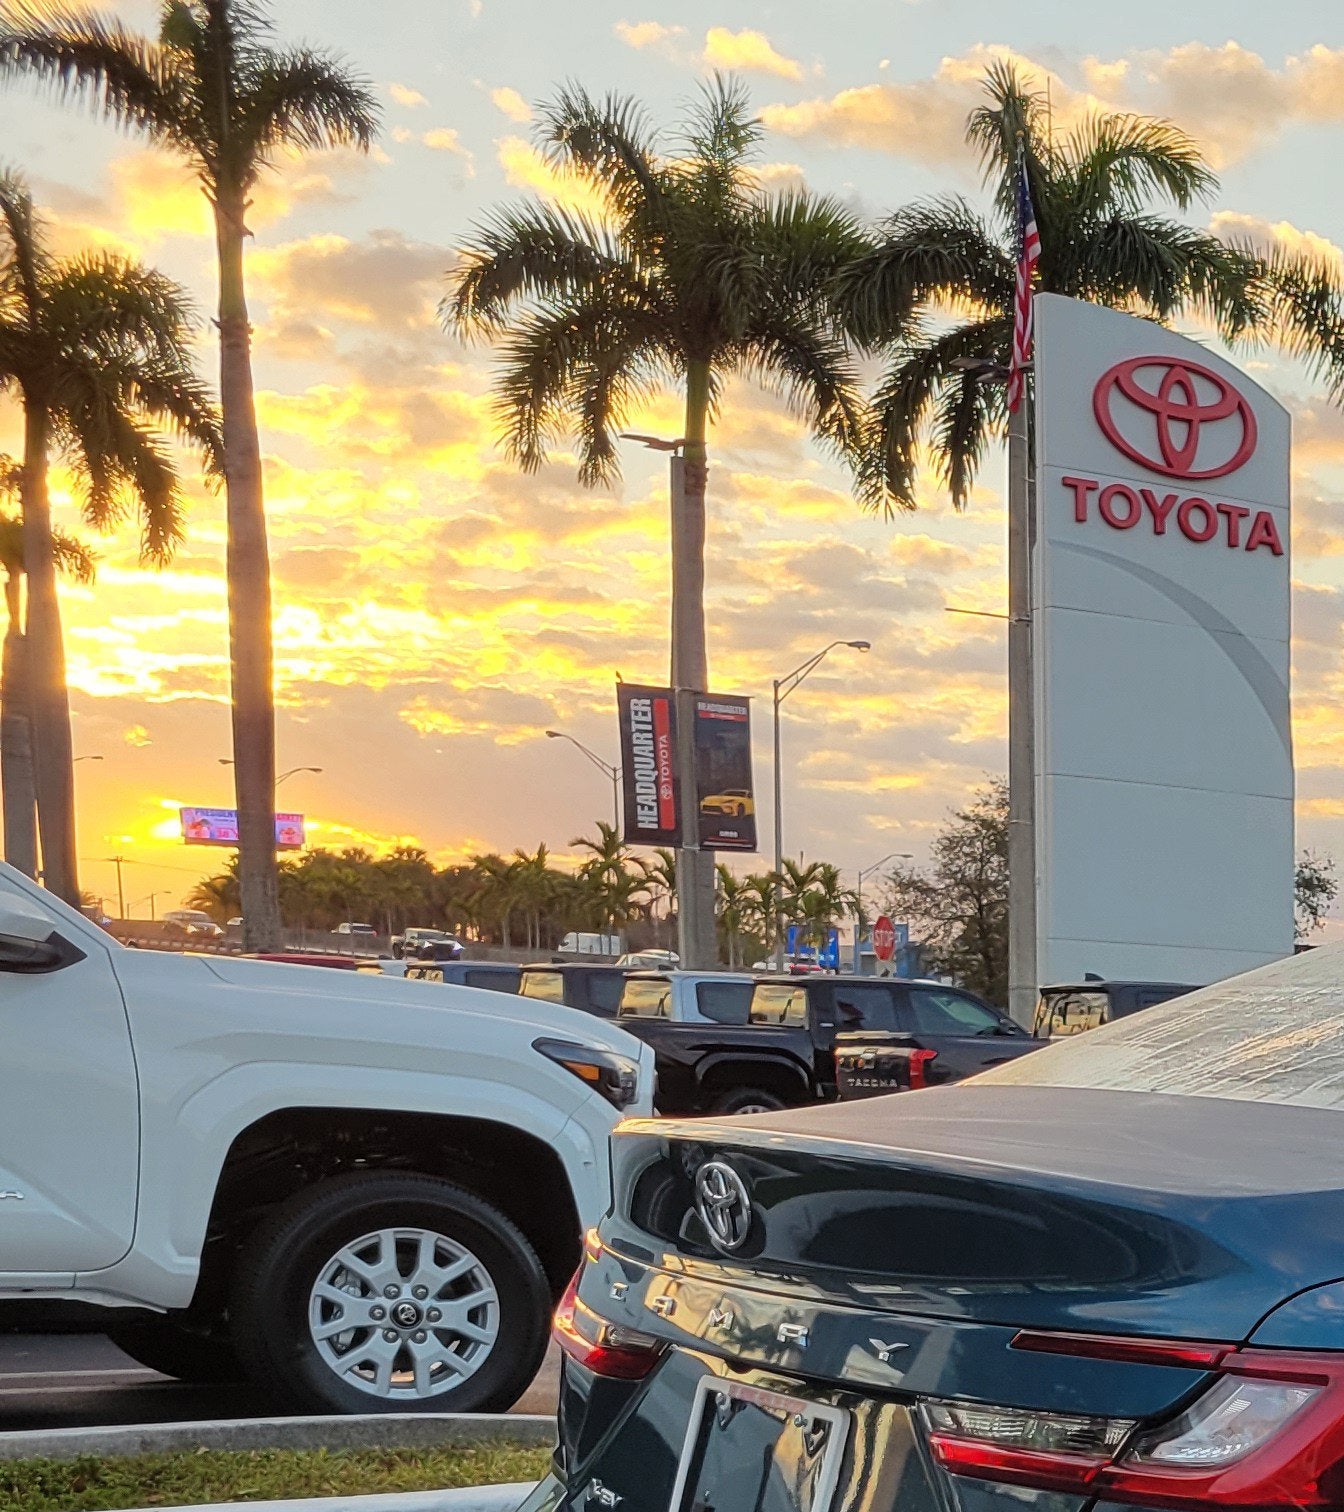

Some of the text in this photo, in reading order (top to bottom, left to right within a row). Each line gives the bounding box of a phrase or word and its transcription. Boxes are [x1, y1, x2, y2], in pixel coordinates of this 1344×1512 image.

[1062, 476, 1284, 555] TOYOTA
[630, 698, 659, 829] HEADQUARTER
[659, 735, 672, 784] TOYOTA
[874, 929, 895, 947] STOP
[609, 1281, 910, 1362] CAMRY
